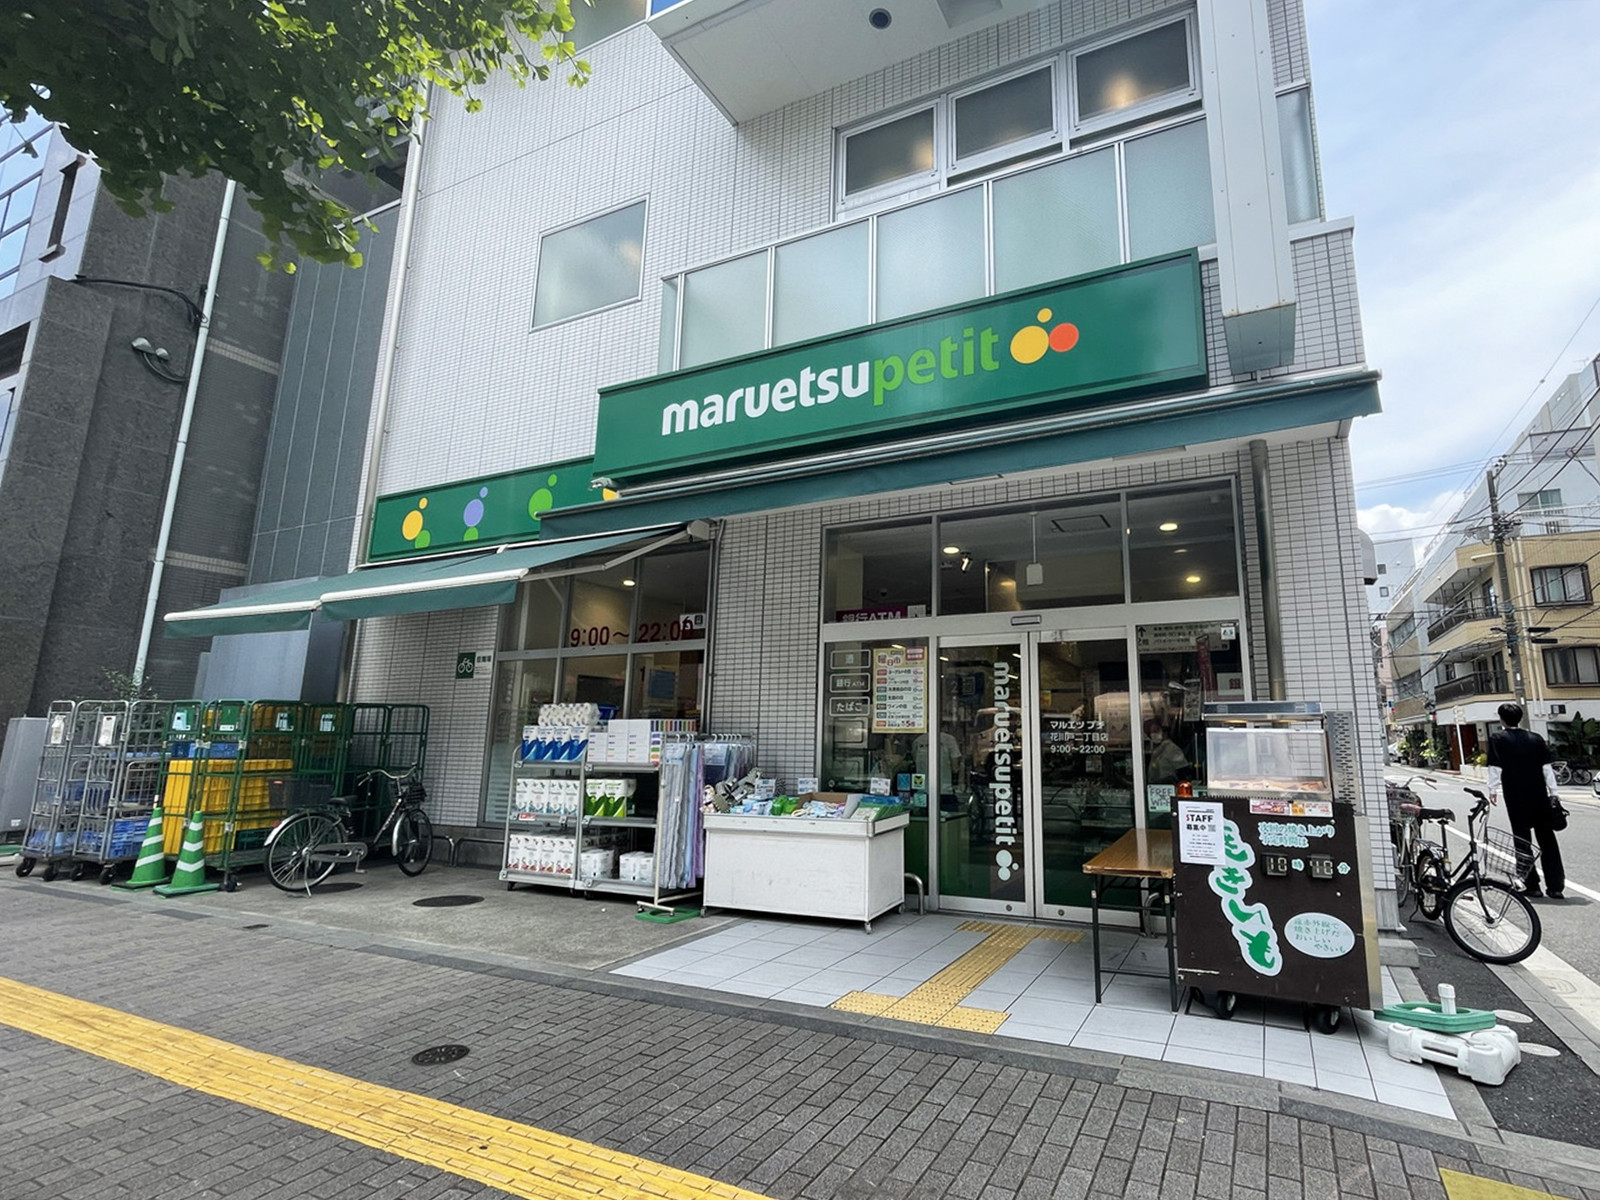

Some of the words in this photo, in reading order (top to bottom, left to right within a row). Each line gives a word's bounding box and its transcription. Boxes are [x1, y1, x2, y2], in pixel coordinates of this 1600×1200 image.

[836, 702, 863, 712] たばこ
[1050, 732, 1109, 742] 花川戸二丁目店
[988, 661, 1018, 846] maruetsupetit
[1150, 788, 1173, 796] FREE
[1151, 798, 1171, 807] Wi-F
[1185, 814, 1213, 823] STAFF
[1260, 823, 1333, 837] 次回の焼き上がり
[1270, 857, 1288, 872] 10
[1294, 925, 1340, 938] 焼き上げた
[1295, 934, 1331, 943] おいしい
